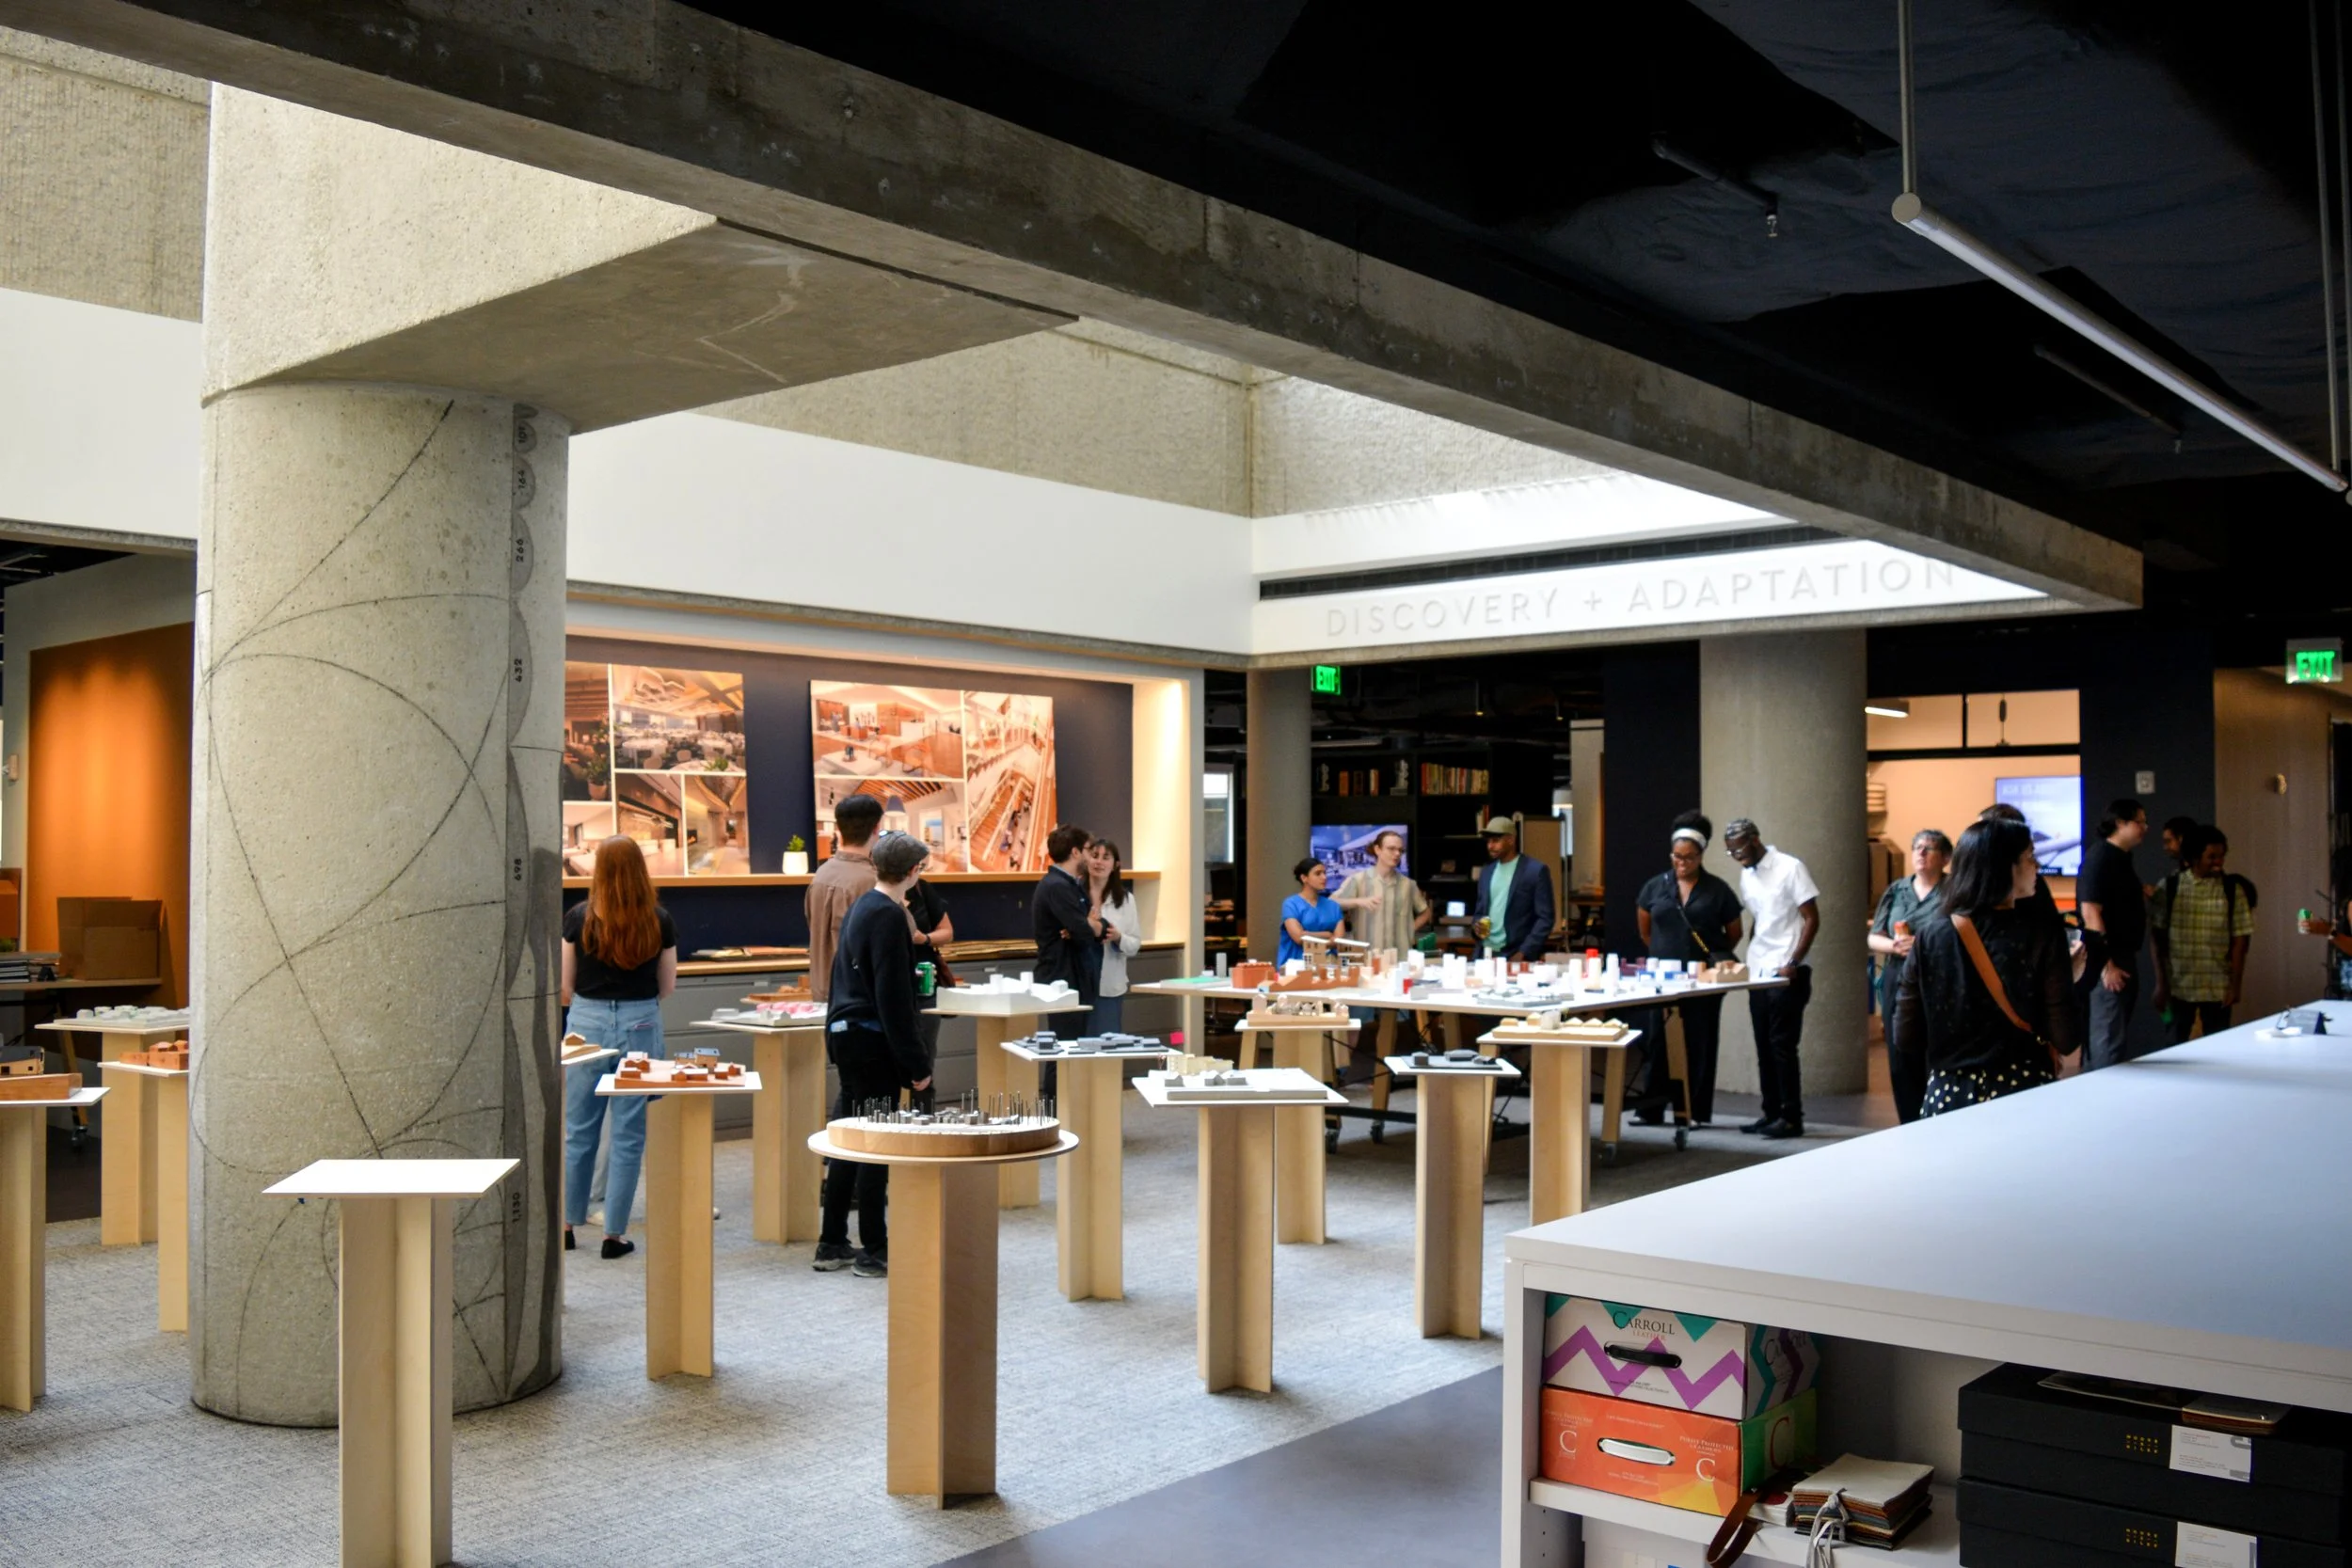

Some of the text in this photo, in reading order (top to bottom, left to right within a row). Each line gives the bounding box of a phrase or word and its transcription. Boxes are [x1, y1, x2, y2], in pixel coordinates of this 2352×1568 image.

[516, 539, 524, 562] 266
[1327, 558, 1954, 637] DISCOVERY + ADAPTATION
[2296, 650, 2335, 680] EXIT
[1315, 665, 1337, 692] EXIT
[1613, 1310, 1676, 1335] CARROLL
[1559, 1430, 1577, 1453] C
[1695, 1457, 1716, 1482] C
